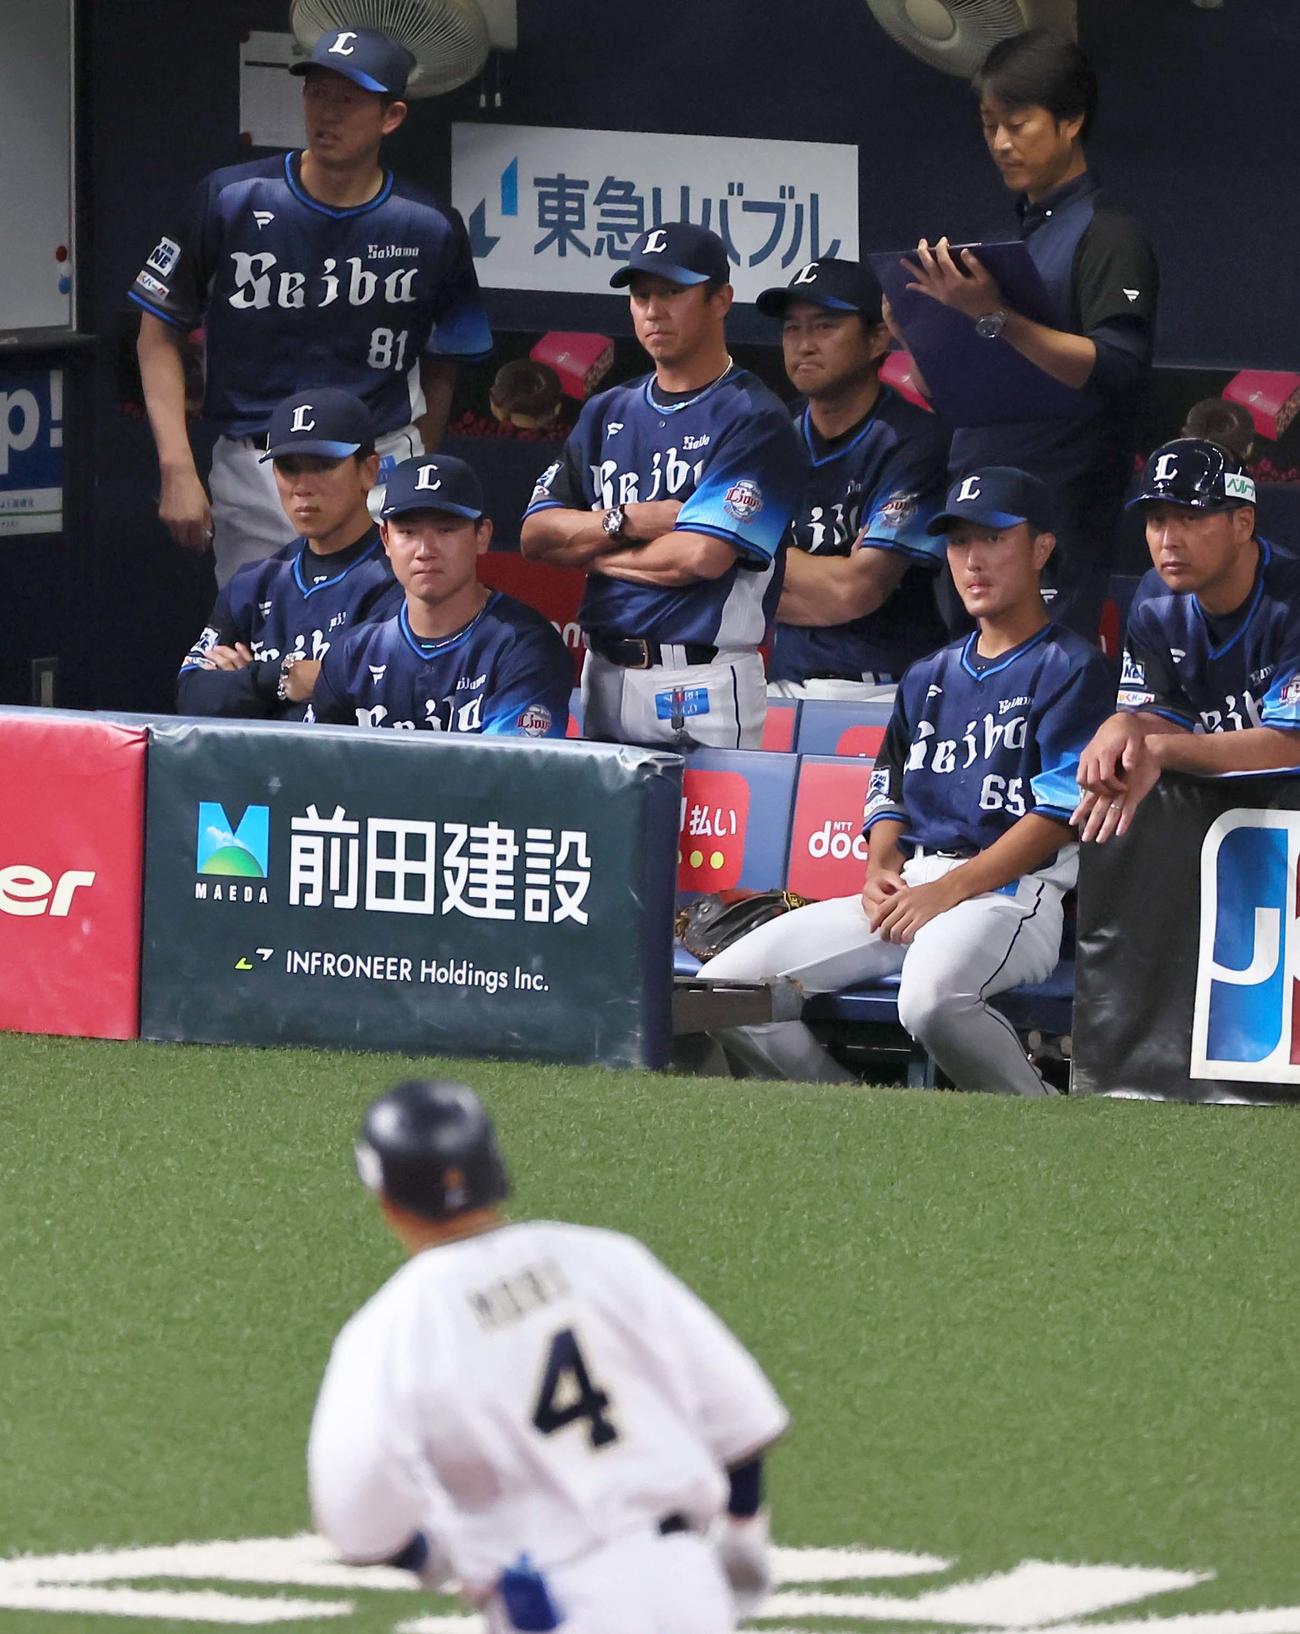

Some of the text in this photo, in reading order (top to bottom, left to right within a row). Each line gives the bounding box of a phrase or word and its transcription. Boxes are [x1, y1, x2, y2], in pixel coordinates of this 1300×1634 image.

[643, 229, 668, 254] L
[794, 262, 820, 285] L
[366, 326, 410, 371] 81
[289, 404, 316, 432] L
[414, 463, 442, 491] L
[1153, 453, 1179, 482] L
[955, 475, 982, 502] L
[978, 773, 1027, 817] 65
[808, 820, 869, 860] doc
[833, 821, 853, 832] NTT
[289, 804, 592, 925] 前田建設
[195, 882, 268, 904] MAEDA
[286, 950, 549, 994] INFRONEER Holdings Inc.
[533, 1327, 619, 1449] 4
